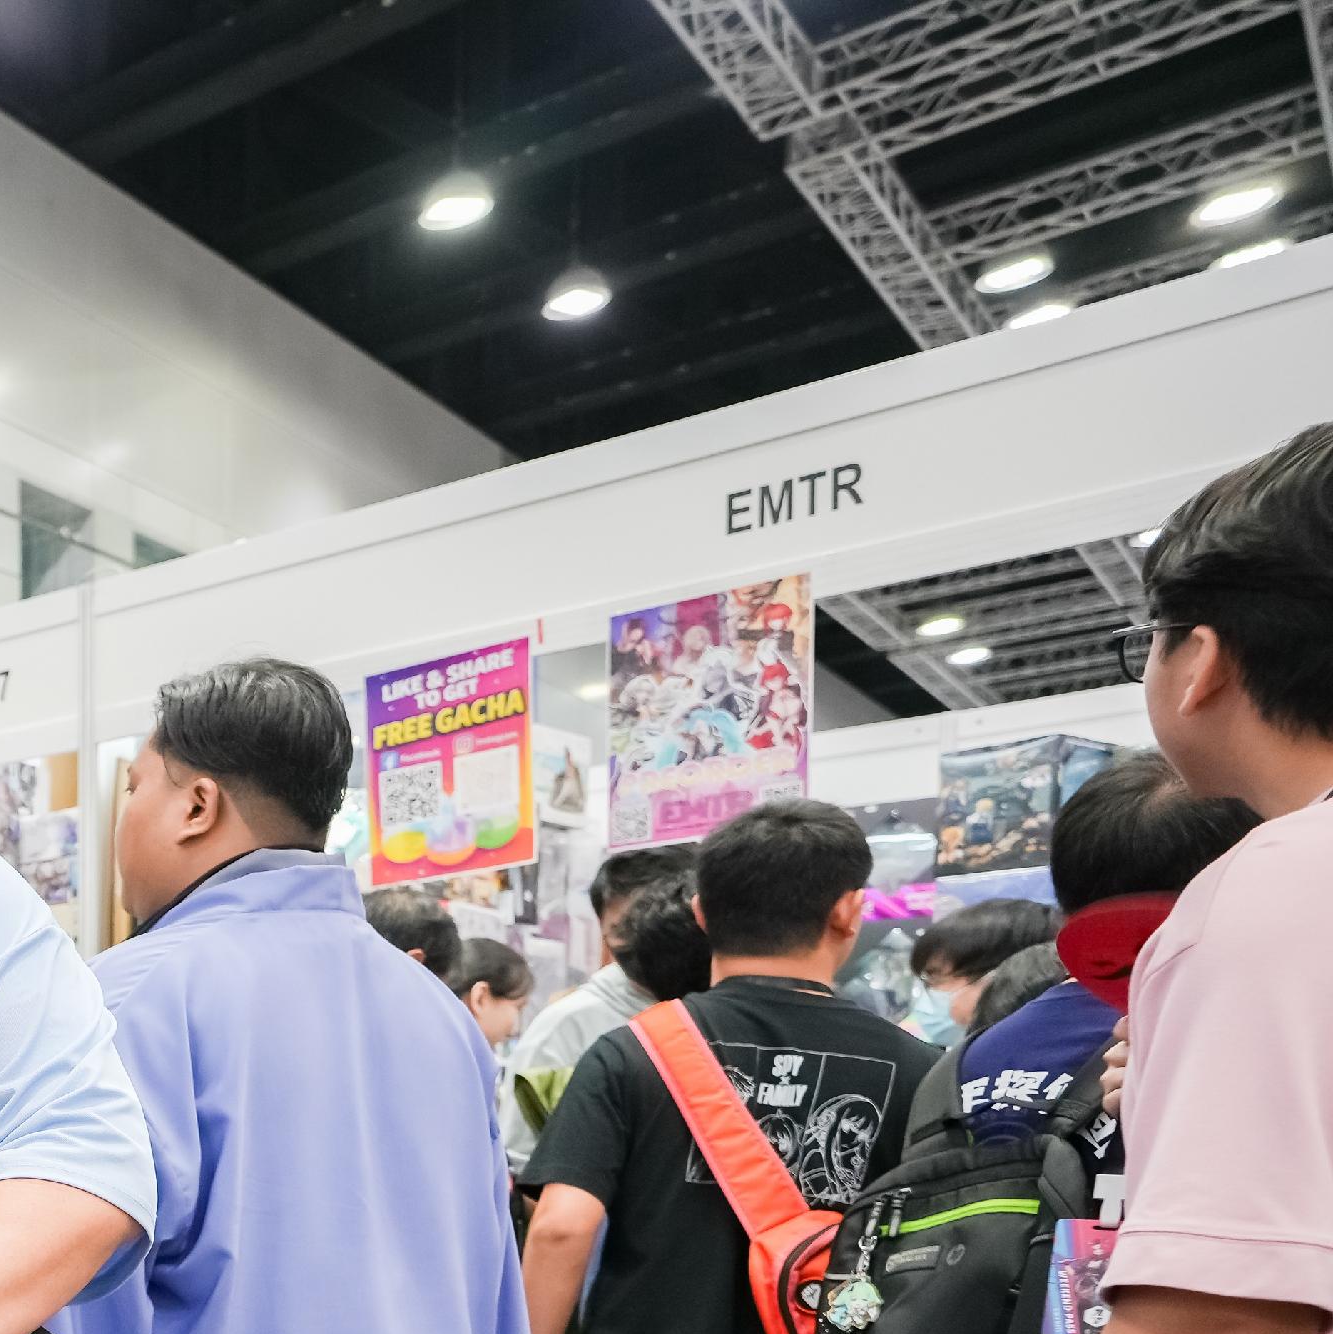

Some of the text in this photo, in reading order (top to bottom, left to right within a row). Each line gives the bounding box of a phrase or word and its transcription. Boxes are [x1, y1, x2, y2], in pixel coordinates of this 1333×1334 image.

[726, 463, 864, 535] EMTR
[381, 674, 425, 703] LIKE
[445, 648, 514, 685] SHARE
[413, 678, 479, 710] TO GET
[372, 688, 527, 751] FREE GACHA
[772, 1054, 804, 1077] SPY
